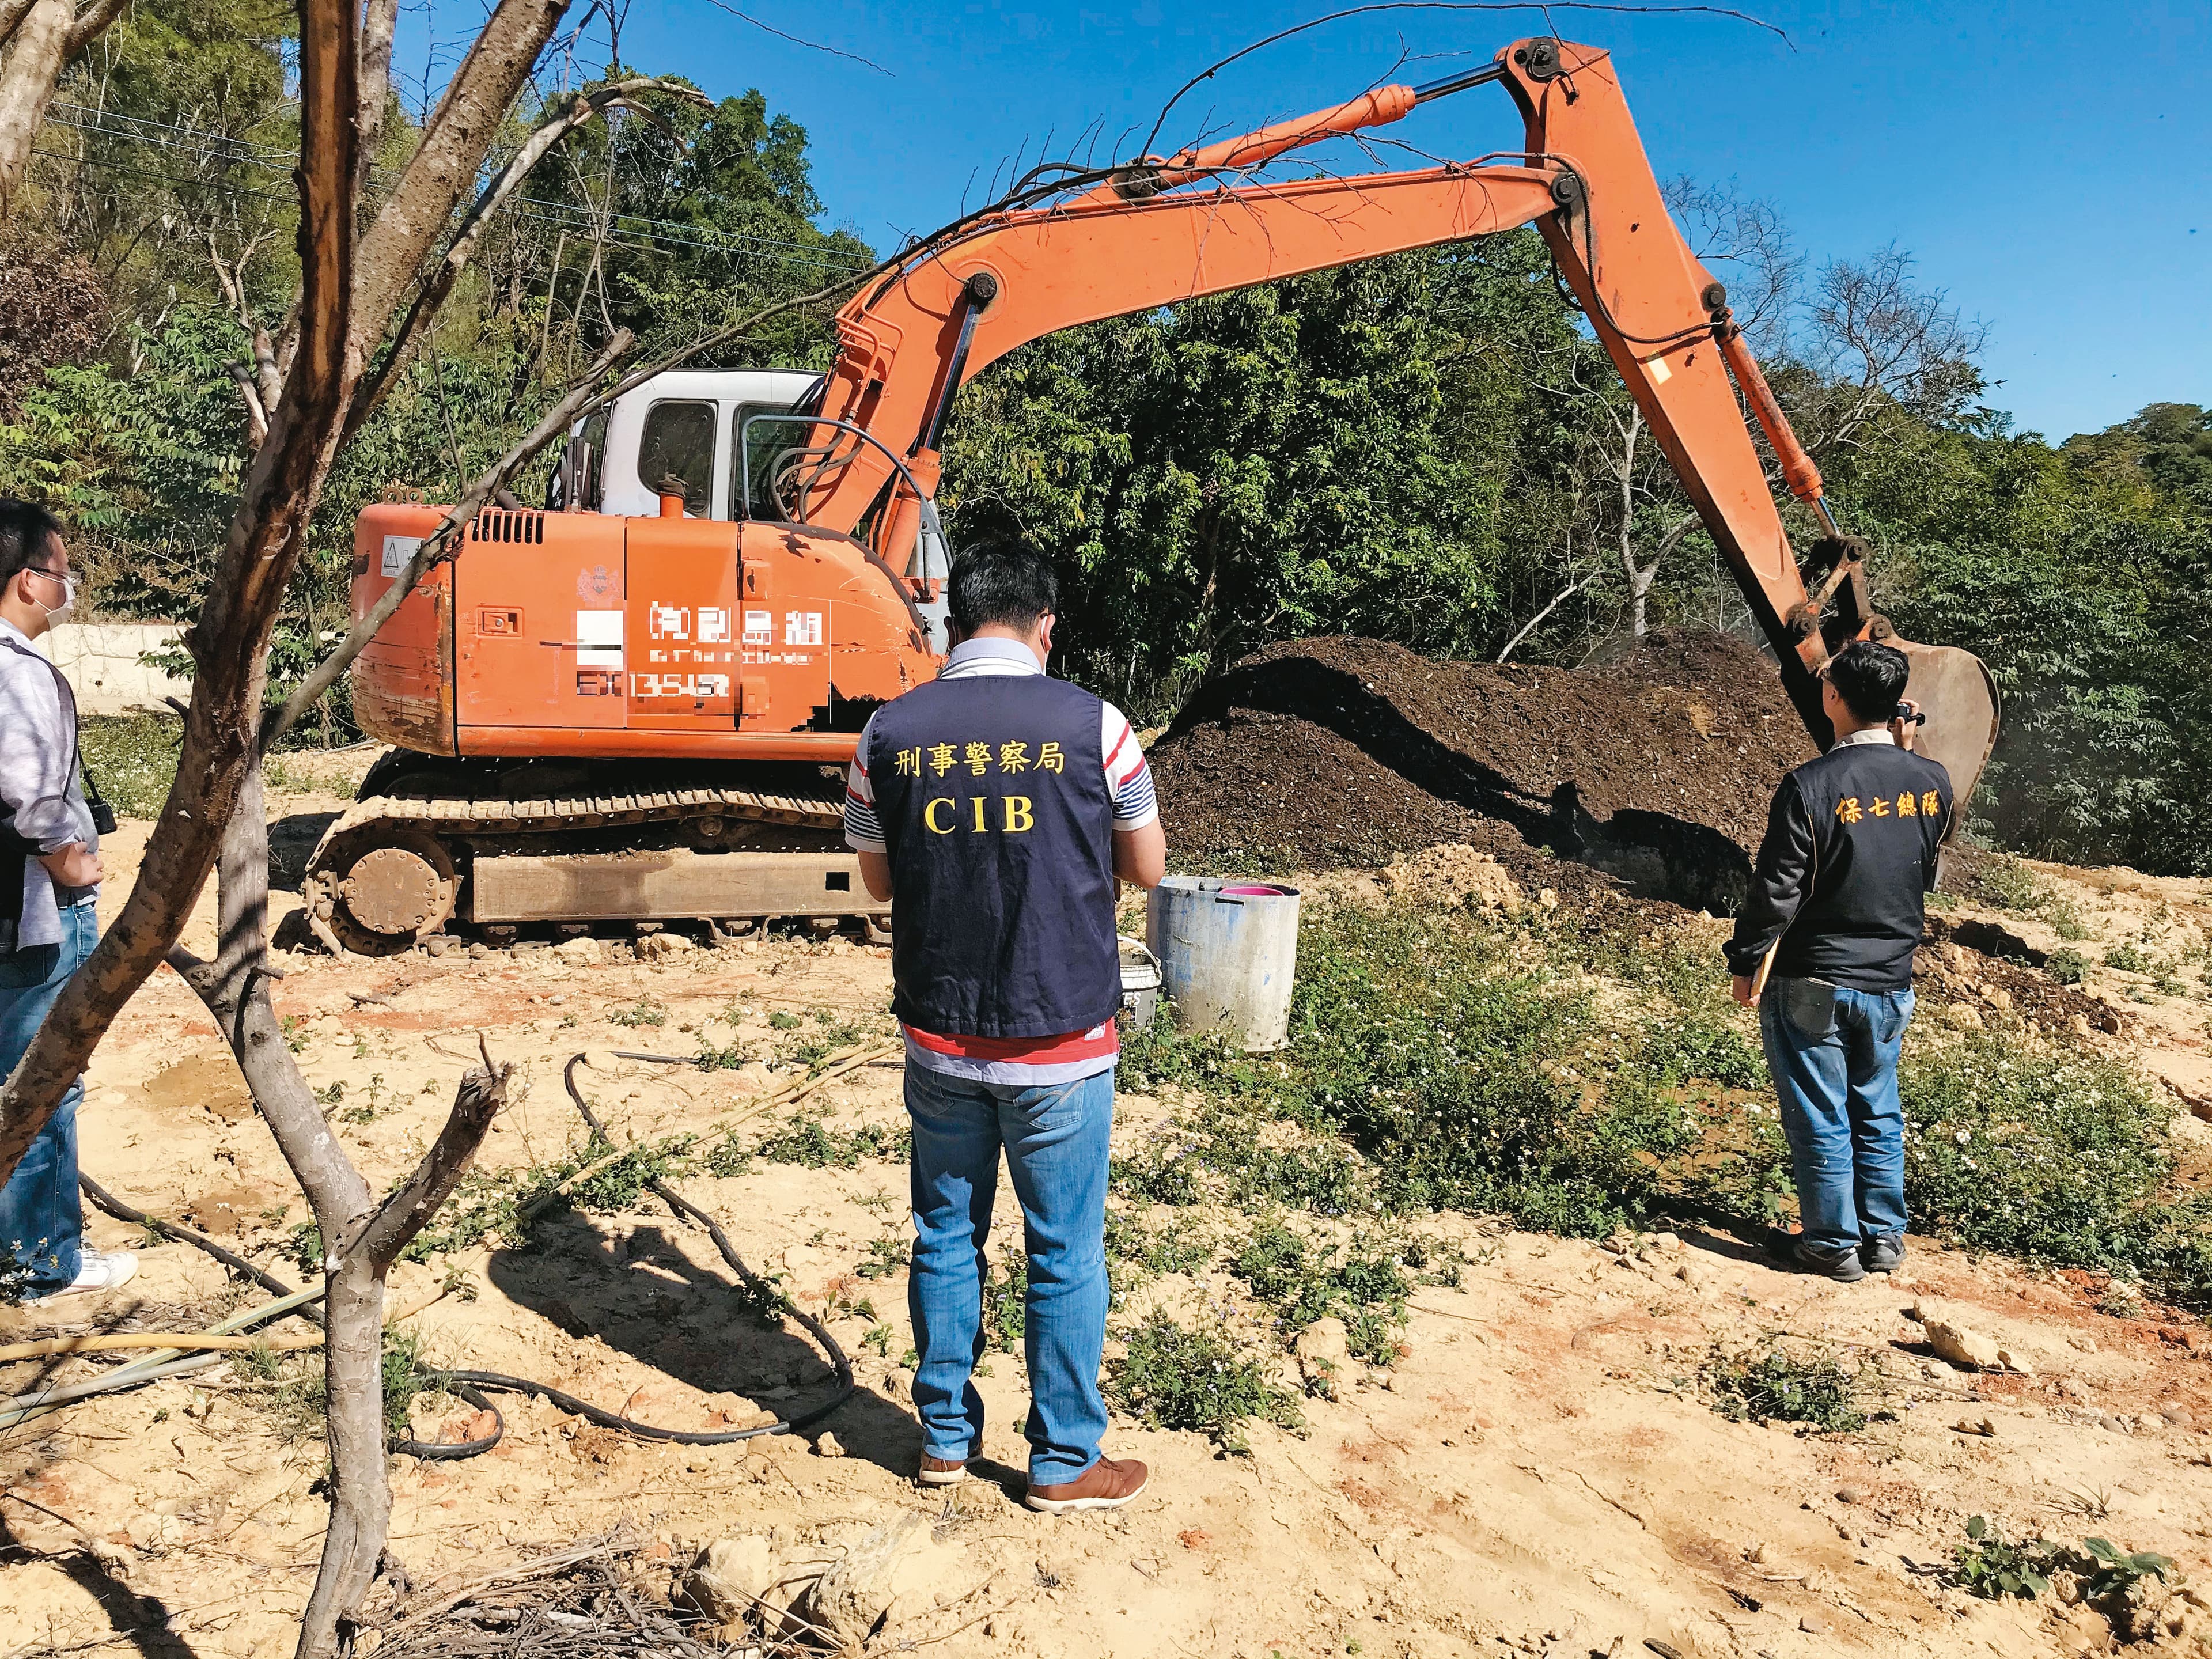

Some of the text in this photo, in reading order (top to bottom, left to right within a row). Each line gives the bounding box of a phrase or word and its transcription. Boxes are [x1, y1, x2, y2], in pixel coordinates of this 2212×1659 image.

[893, 740, 1065, 778] 刑事警察局
[925, 796, 1035, 834] CIB
[1835, 790, 1938, 824] 保七總隊
